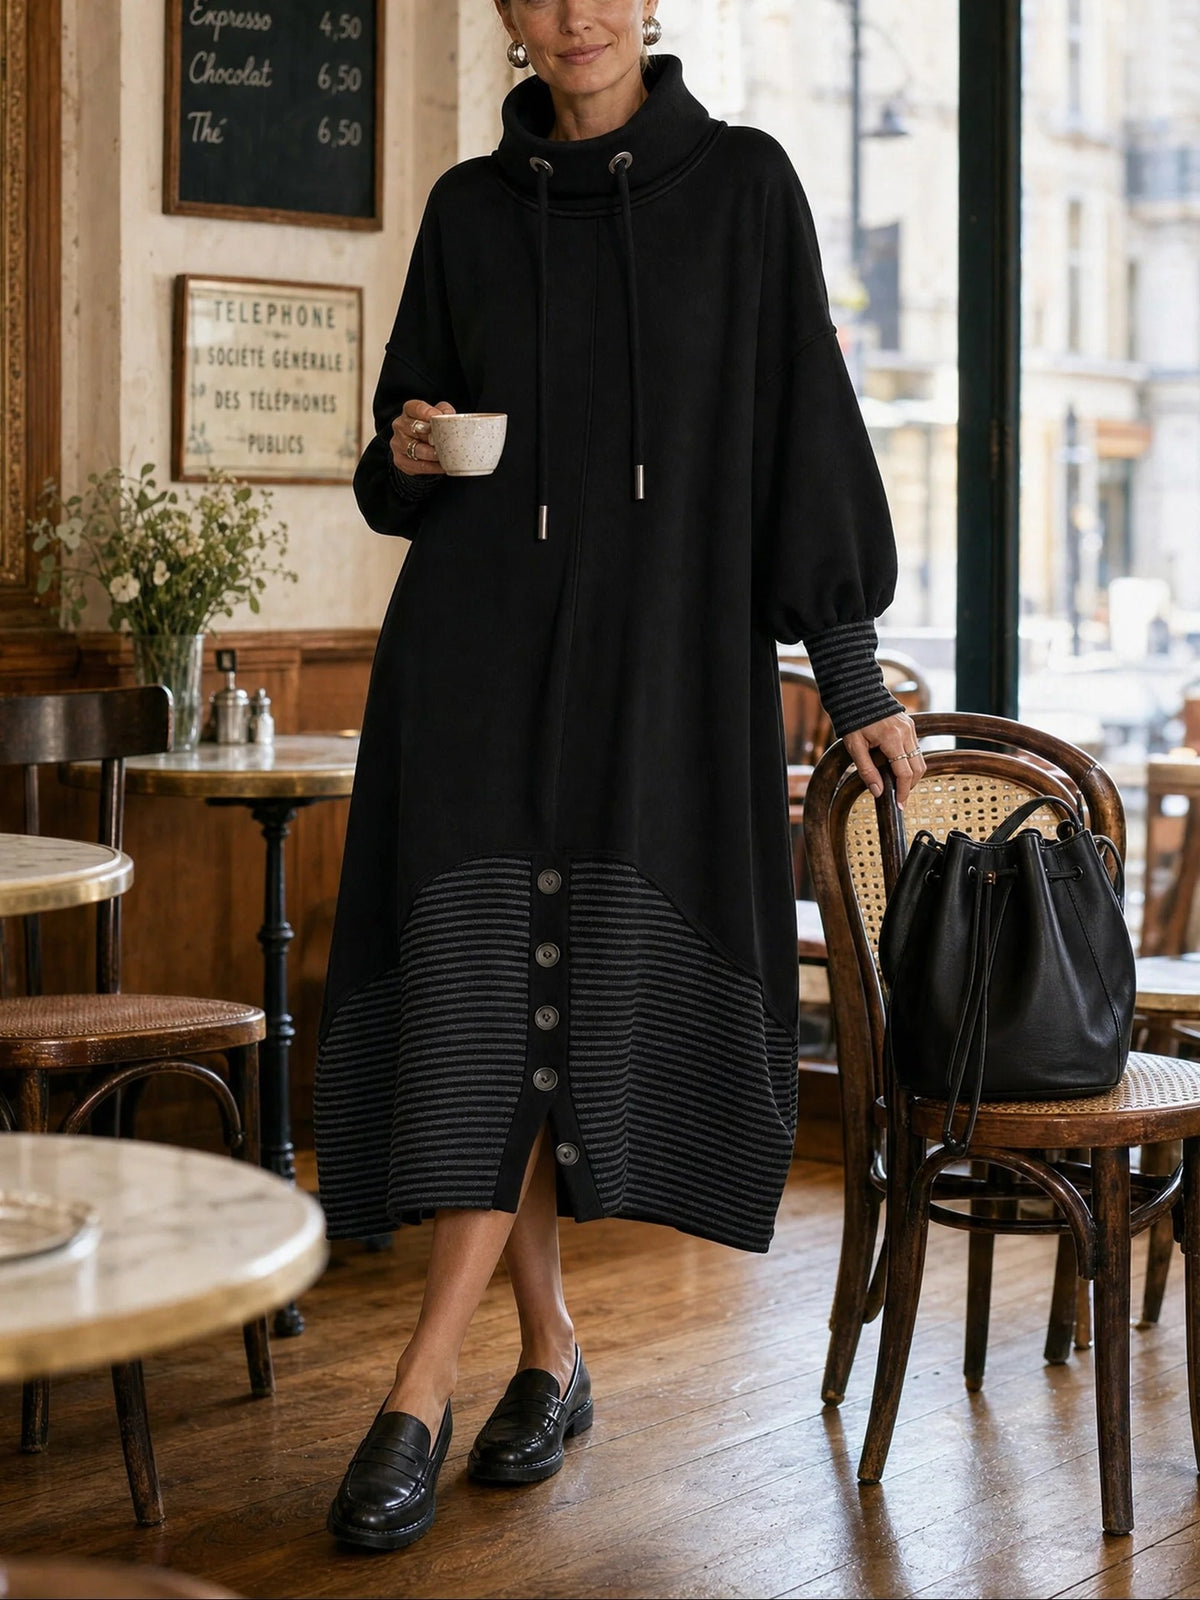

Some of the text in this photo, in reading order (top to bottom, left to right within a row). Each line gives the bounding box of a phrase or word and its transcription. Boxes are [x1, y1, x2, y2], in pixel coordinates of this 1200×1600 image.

[190, 0, 362, 42] Expresso 4,50
[189, 51, 362, 95] Chocolat 6,50
[187, 111, 362, 148] Thé 6,50
[214, 301, 336, 329] TELEPHONE
[215, 390, 241, 410] DES
[248, 434, 305, 455] PUBLICS
